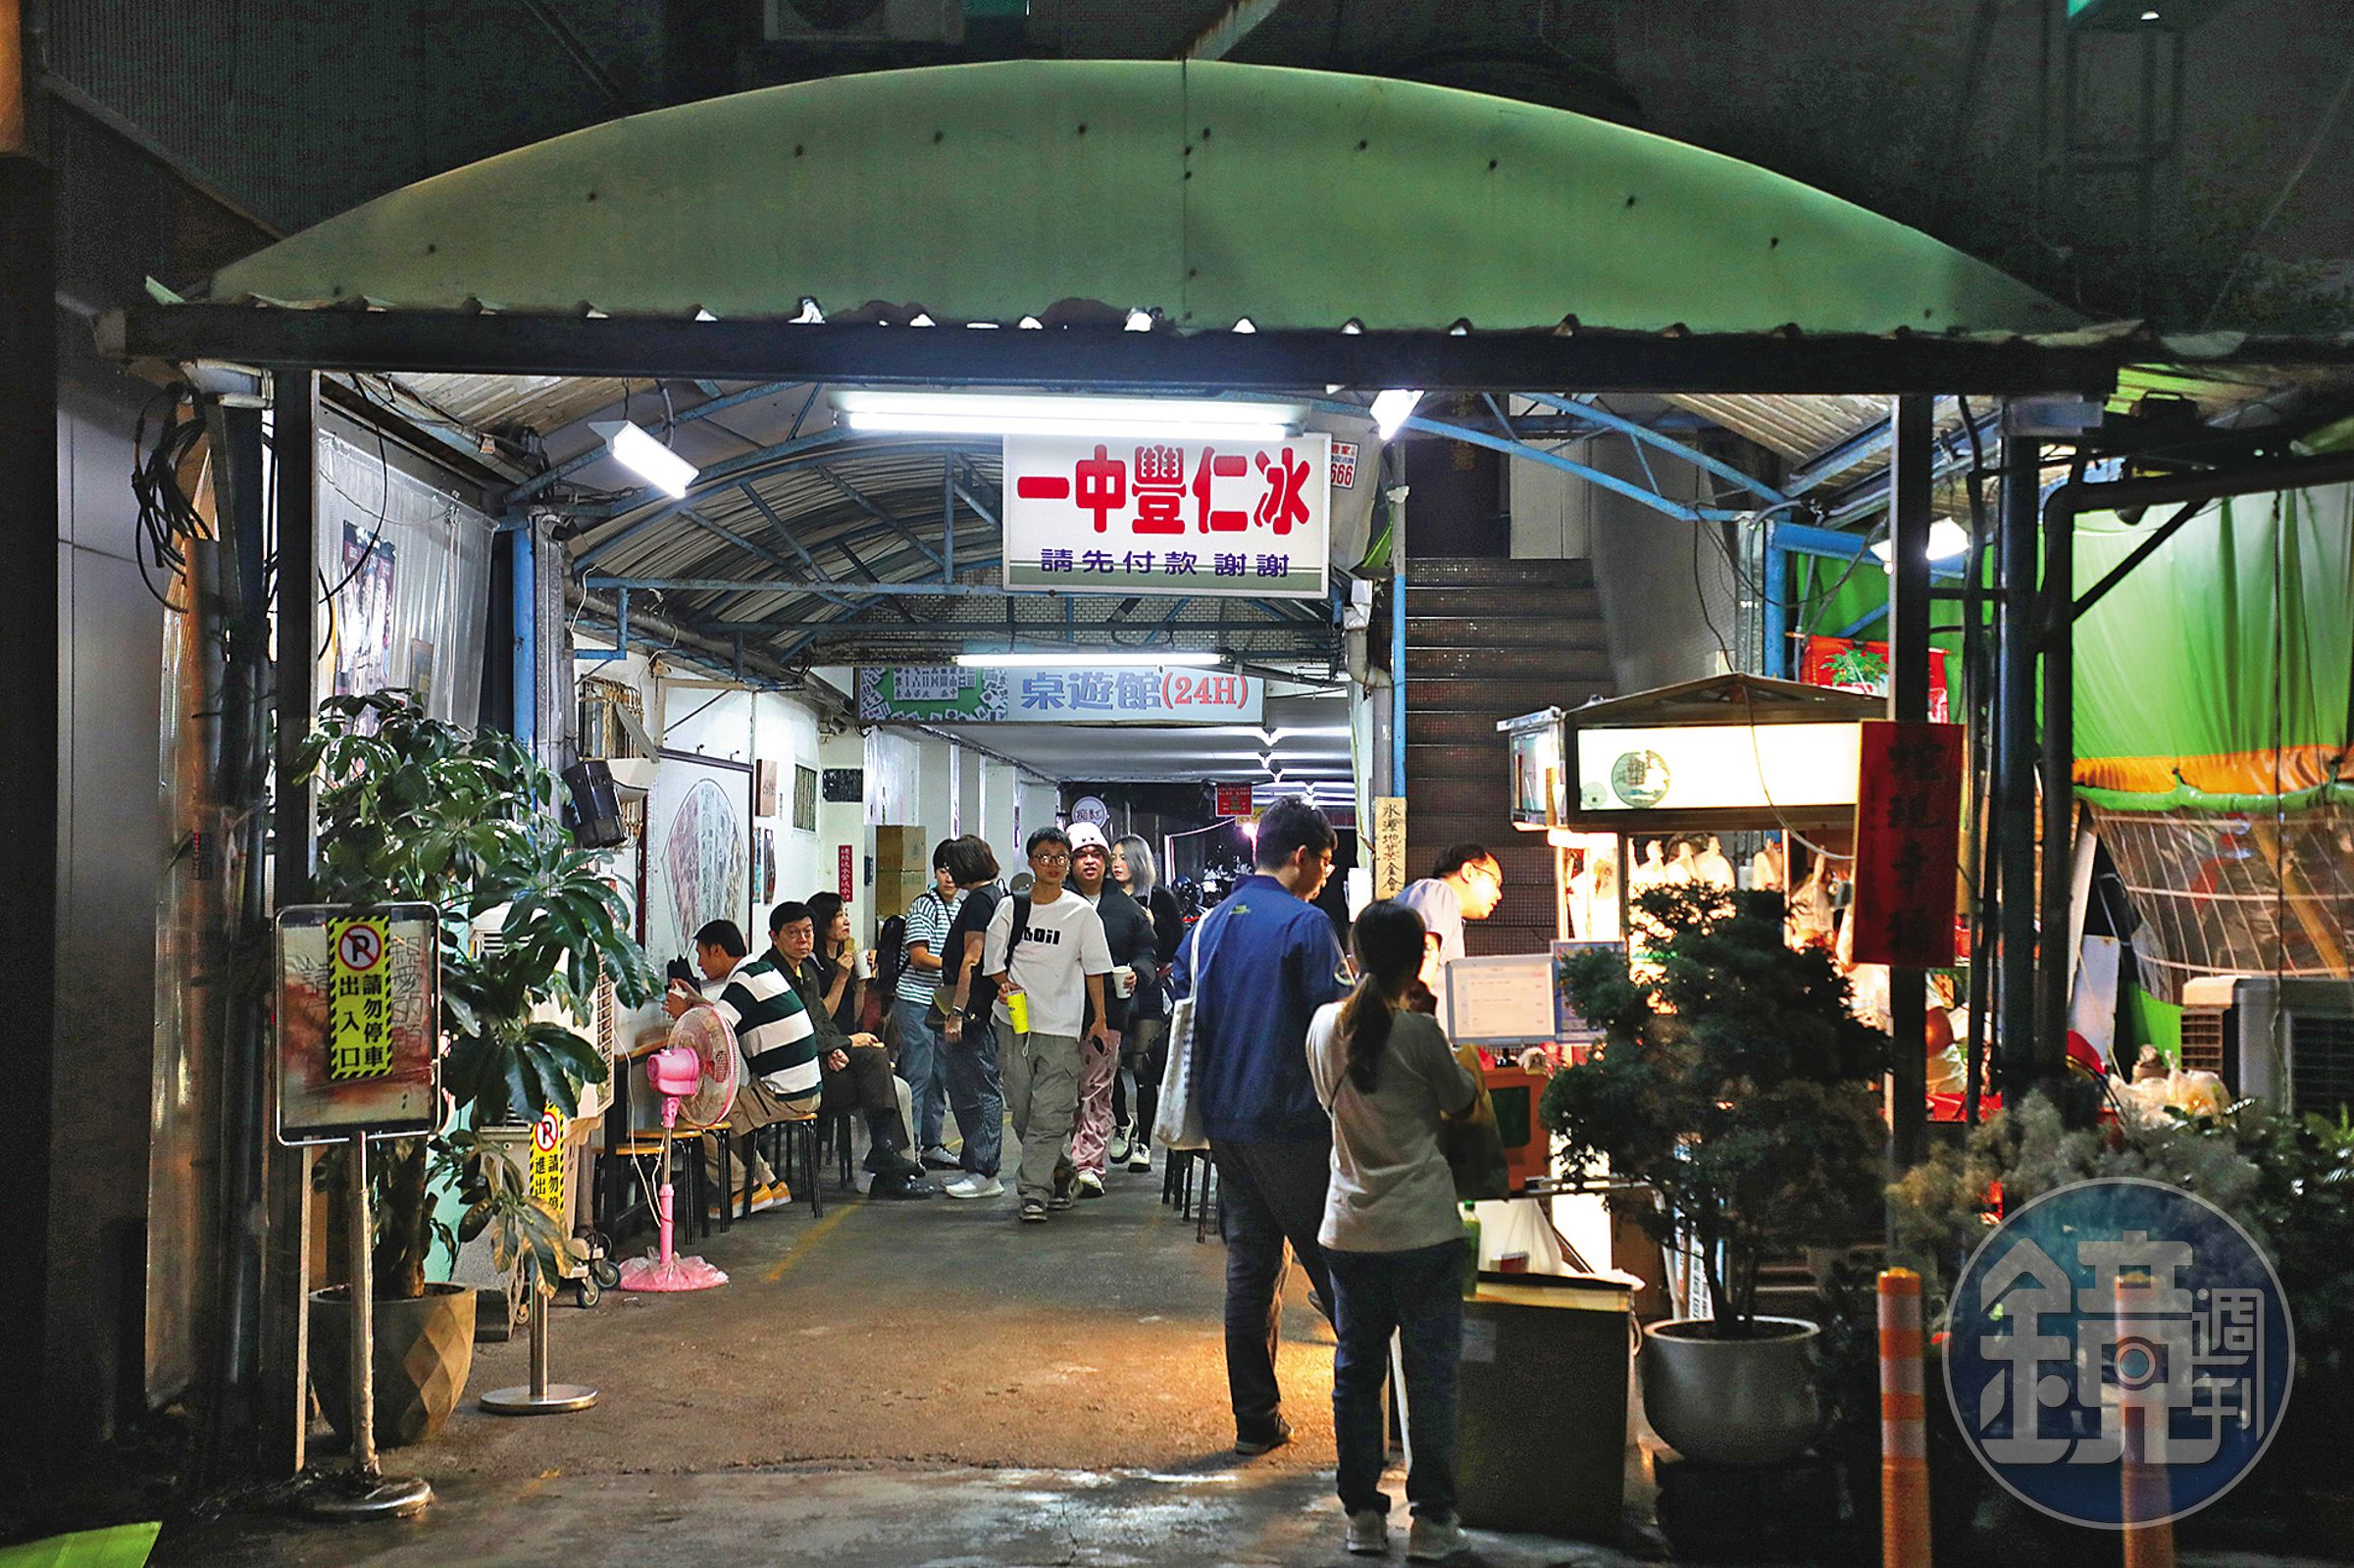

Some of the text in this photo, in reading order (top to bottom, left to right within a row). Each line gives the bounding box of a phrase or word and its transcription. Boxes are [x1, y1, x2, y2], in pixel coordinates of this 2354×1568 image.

[1017, 444, 1310, 534] 一中豐仁冰
[1041, 549, 1290, 577] 請先付款 謝謝
[340, 975, 360, 1068] 出入口
[363, 974, 384, 1068] 請勿停車
